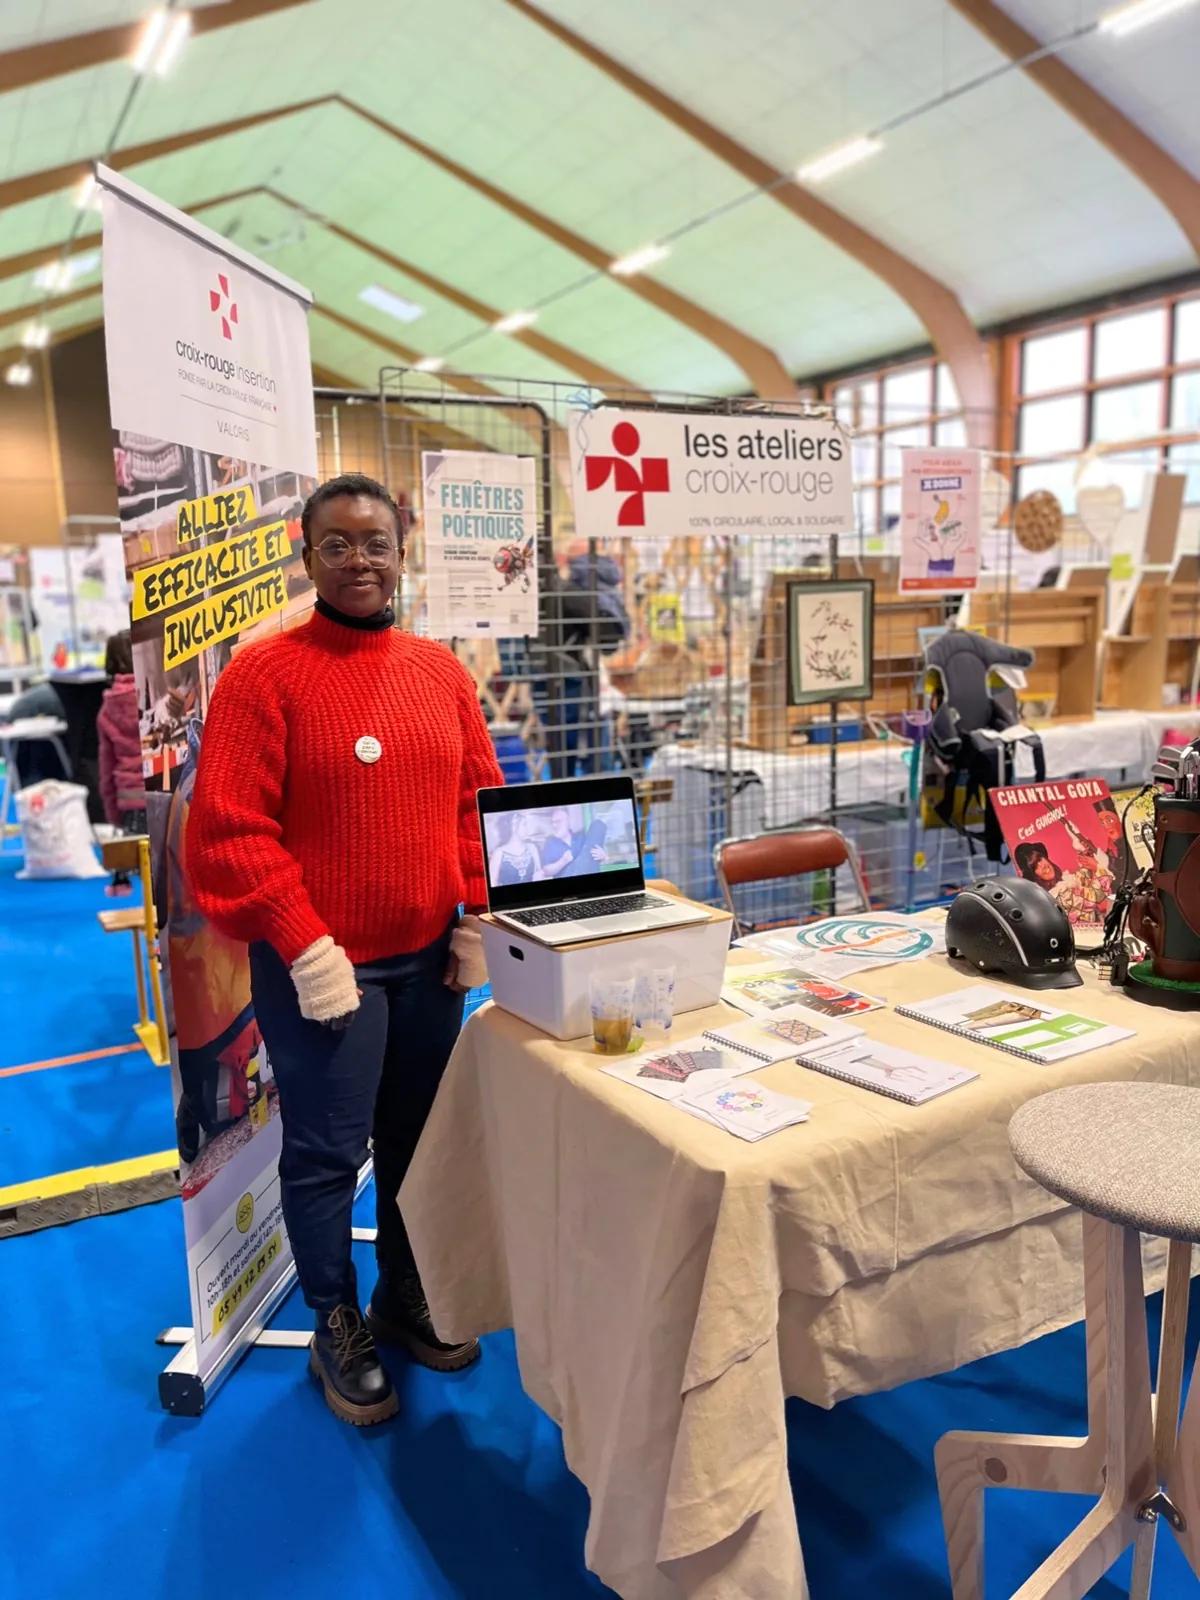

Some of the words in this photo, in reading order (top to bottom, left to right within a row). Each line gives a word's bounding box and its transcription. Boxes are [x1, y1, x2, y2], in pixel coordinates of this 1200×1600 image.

[175, 340, 235, 380] croix-rouge
[236, 361, 277, 393] insertion
[684, 424, 729, 459] les
[737, 428, 843, 461] ateliers
[441, 480, 524, 511] FENÊTRES
[685, 462, 834, 501] croix-rouge
[178, 491, 248, 542] ALLIEZ
[442, 510, 525, 541] POÉTIQUES
[768, 516, 796, 527] LOCAL
[142, 531, 260, 612] EFFICACITÉ
[264, 526, 285, 562] ET
[165, 567, 285, 661] INCLUSIVITÉ
[997, 787, 1065, 807] CHANTAL
[1068, 781, 1103, 798] GOYA
[1018, 824, 1035, 841] C'est
[207, 1261, 230, 1293] Ouvert
[230, 1236, 249, 1267] mardi
[249, 1230, 258, 1243] au
[233, 1263, 240, 1277] et
[240, 1236, 262, 1266] samedi
[218, 1299, 229, 1323] 05
